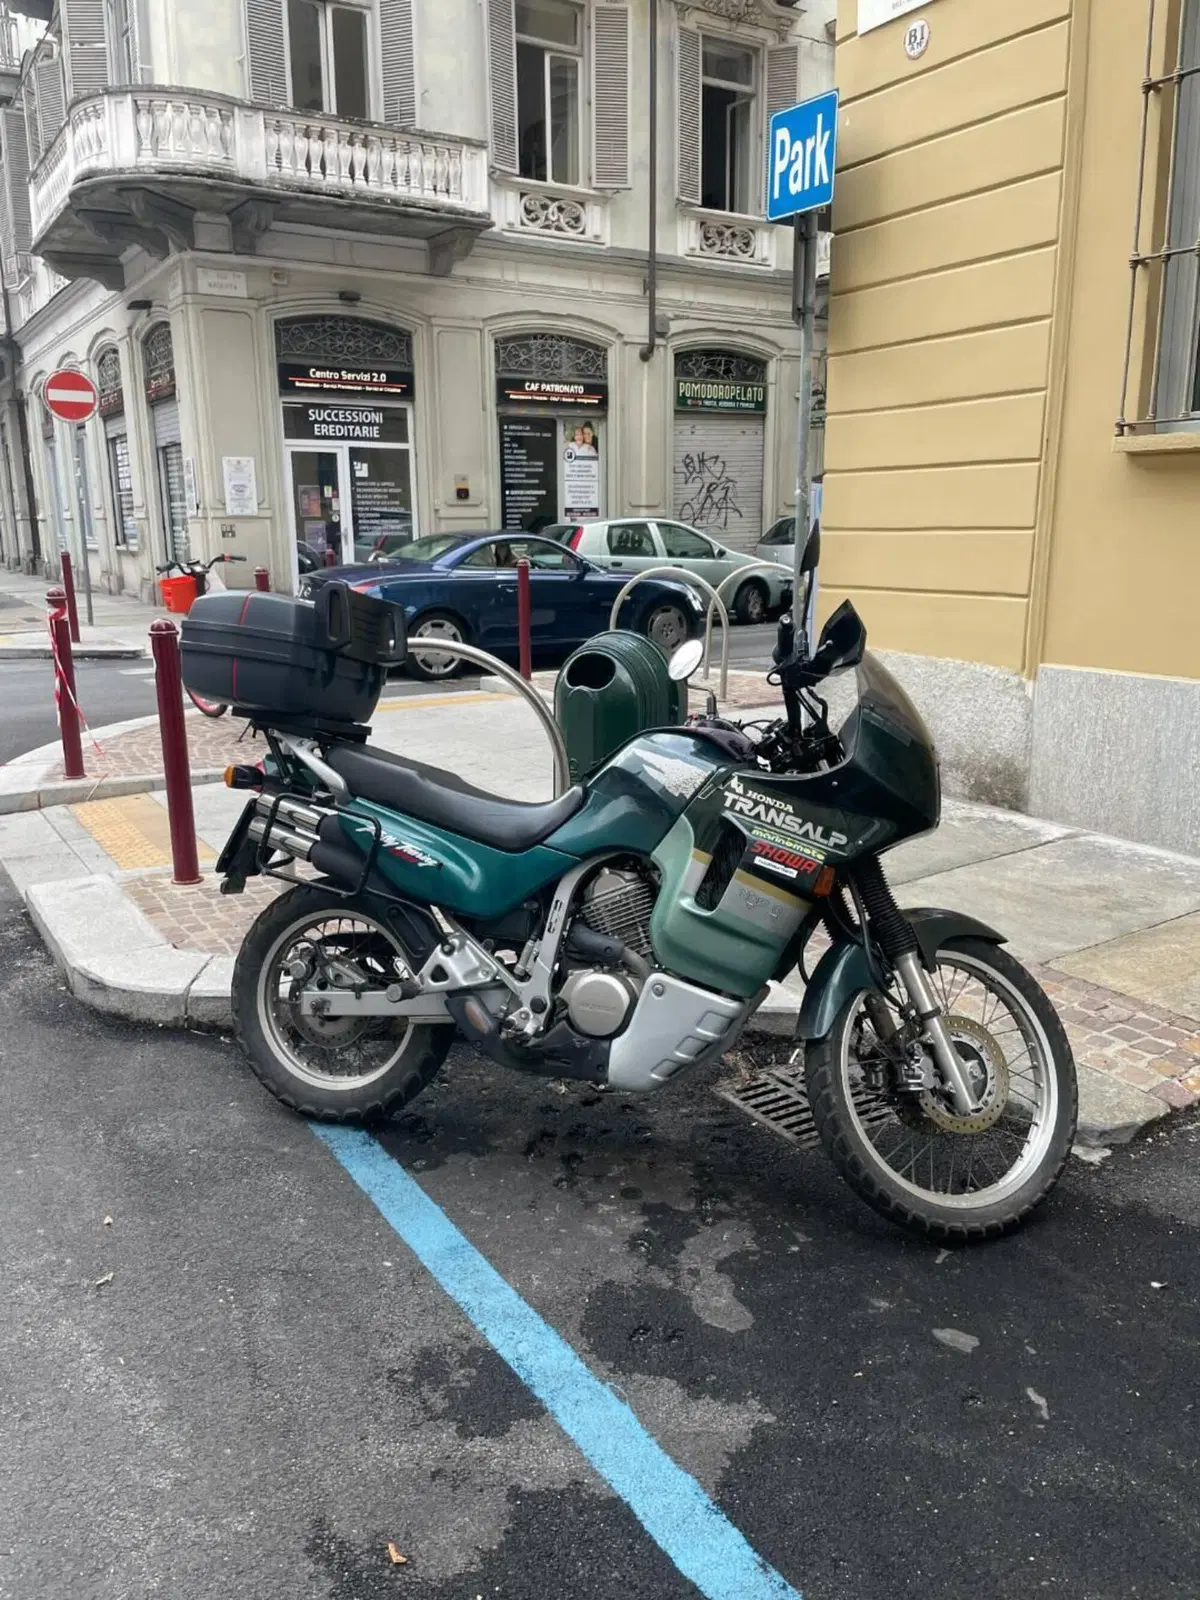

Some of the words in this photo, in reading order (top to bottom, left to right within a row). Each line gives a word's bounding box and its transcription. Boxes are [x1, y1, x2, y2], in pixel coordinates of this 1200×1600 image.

[773, 113, 831, 200] Park
[309, 368, 340, 380] Centro
[341, 370, 371, 382] Servizi
[372, 372, 387, 383] 2.0
[525, 382, 540, 392] CAF
[541, 383, 584, 394] PATRONATO
[679, 382, 764, 402] POMODOROPELATO
[308, 408, 384, 424] SUCCESSIONI
[314, 424, 381, 438] EREDITARIE
[746, 789, 795, 814] HONDA
[723, 791, 848, 848] TRANSALP
[751, 839, 818, 875] SHOWA
